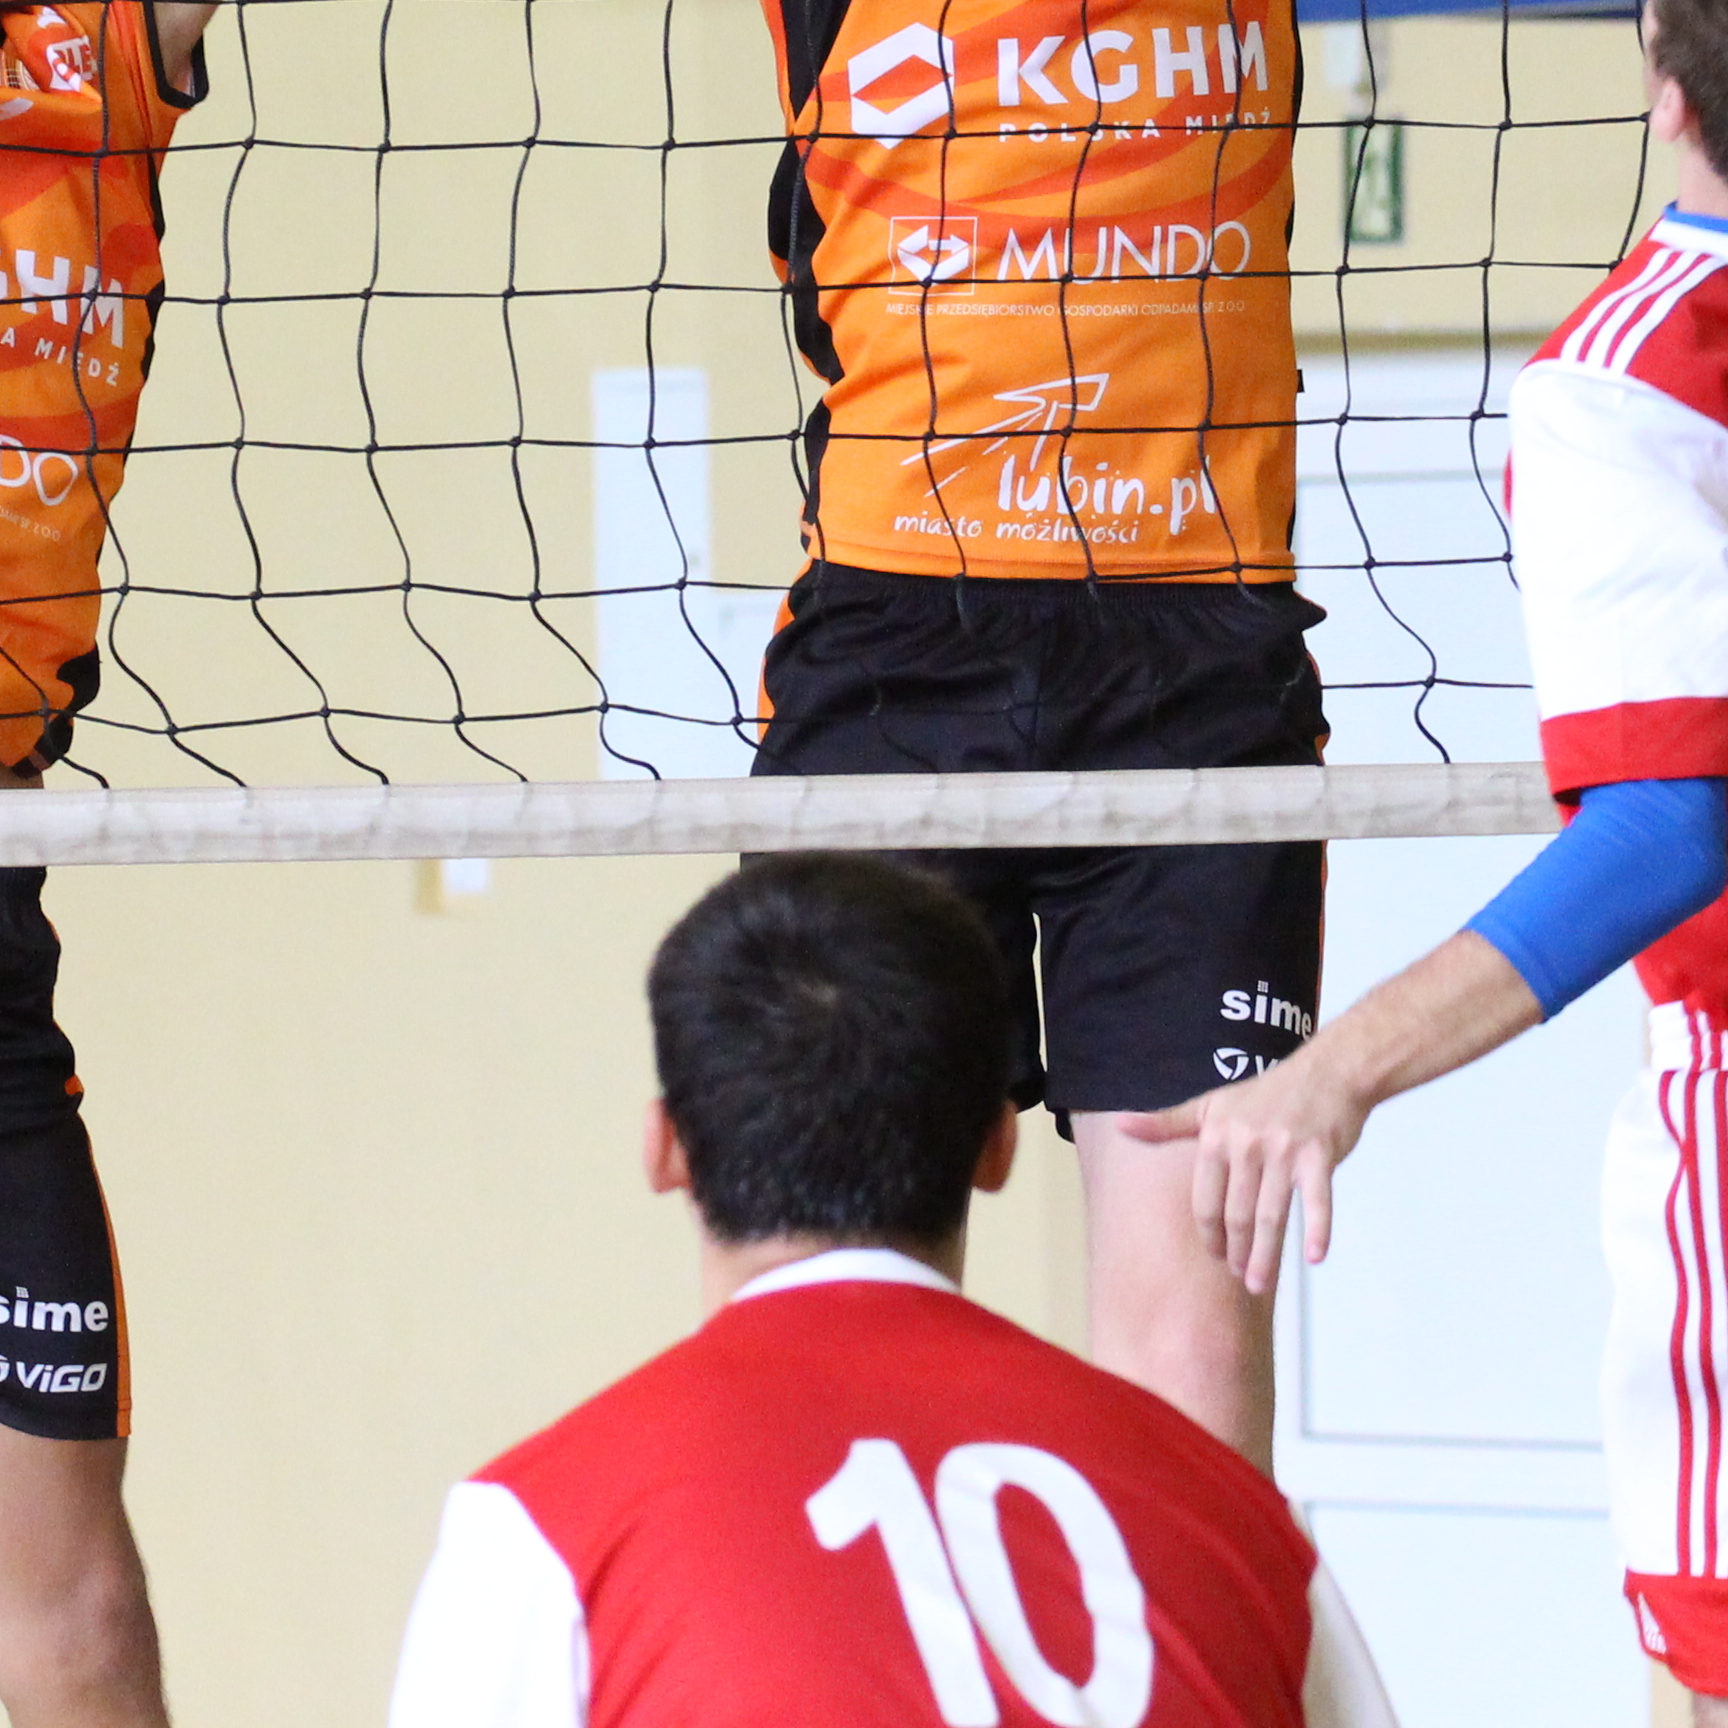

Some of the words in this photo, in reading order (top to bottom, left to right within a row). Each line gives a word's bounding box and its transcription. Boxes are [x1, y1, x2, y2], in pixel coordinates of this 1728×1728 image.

[996, 20, 1269, 107] KGHM
[998, 118, 1162, 143] POLSKA
[995, 220, 1252, 286] MUNDO
[893, 510, 982, 538] miasto
[997, 454, 1217, 535] lubin.pl
[1220, 980, 1312, 1042] sime
[804, 1437, 1155, 1728] 10
